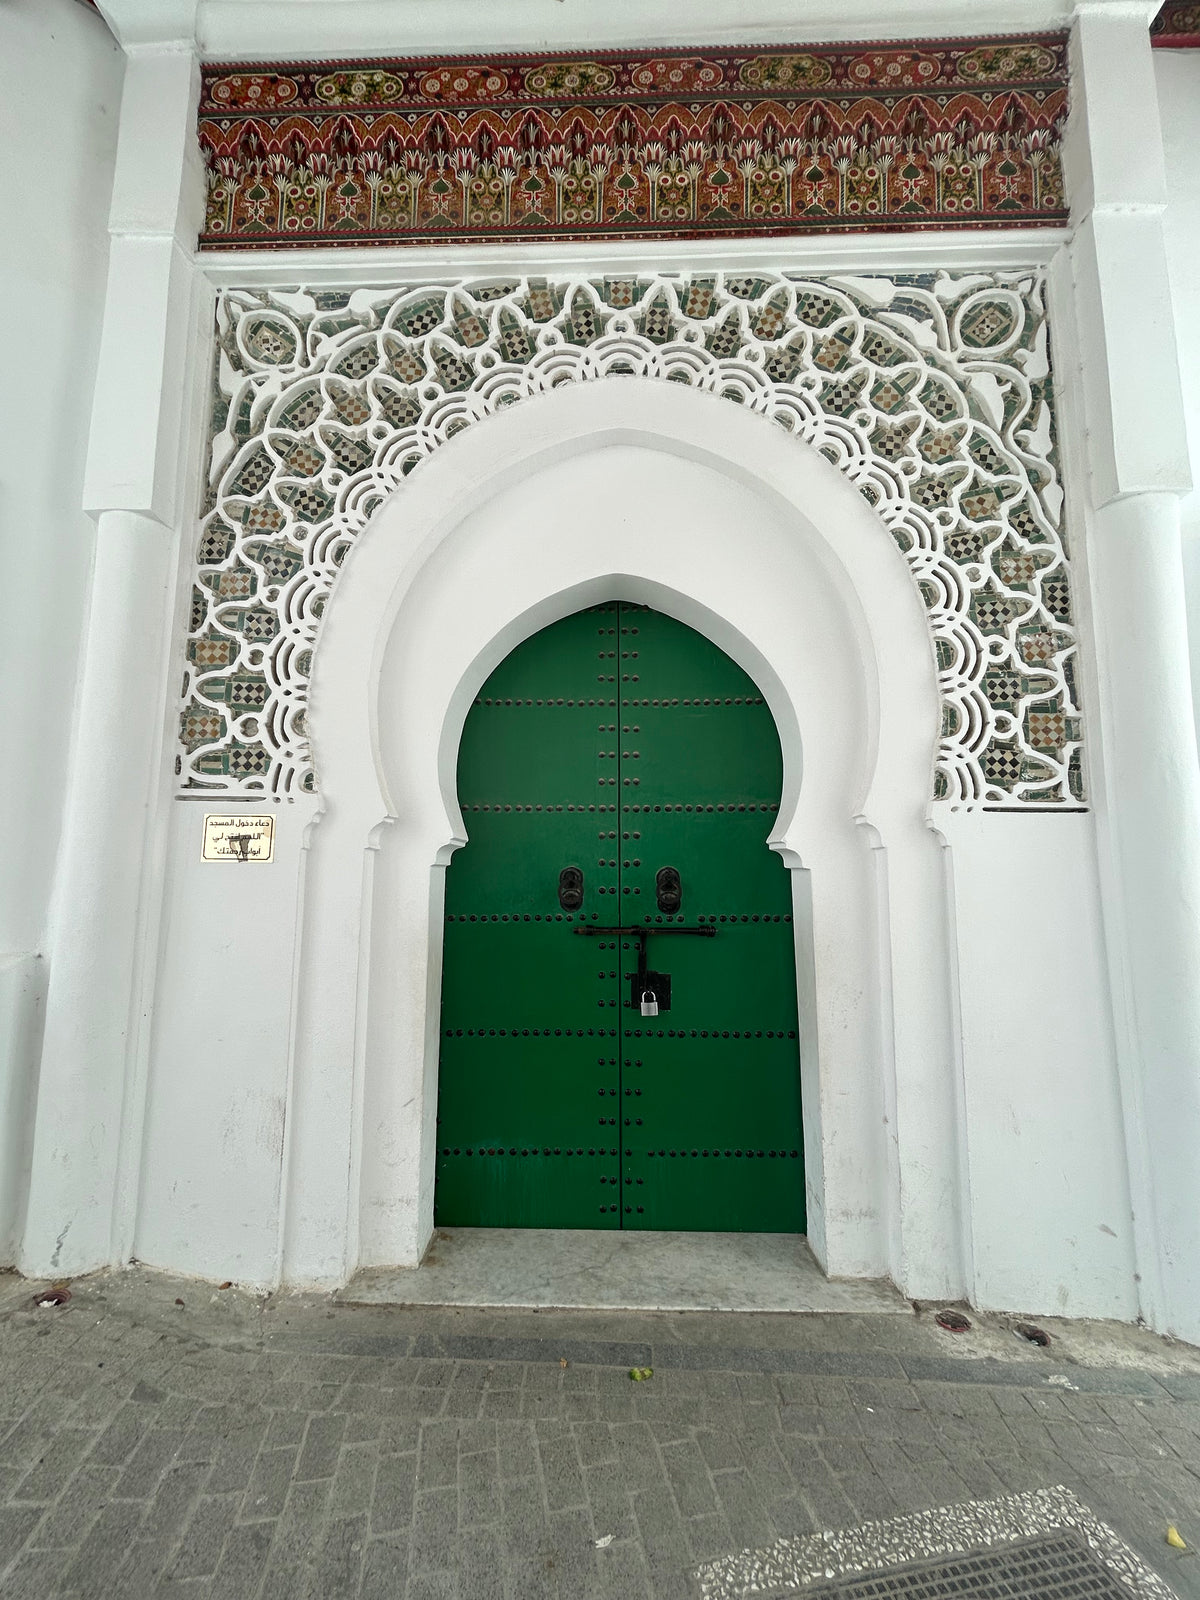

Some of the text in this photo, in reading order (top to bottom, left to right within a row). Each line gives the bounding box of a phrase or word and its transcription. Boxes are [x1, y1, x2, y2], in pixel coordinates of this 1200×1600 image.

[209, 819, 270, 828] دعاء دخول المسجد
